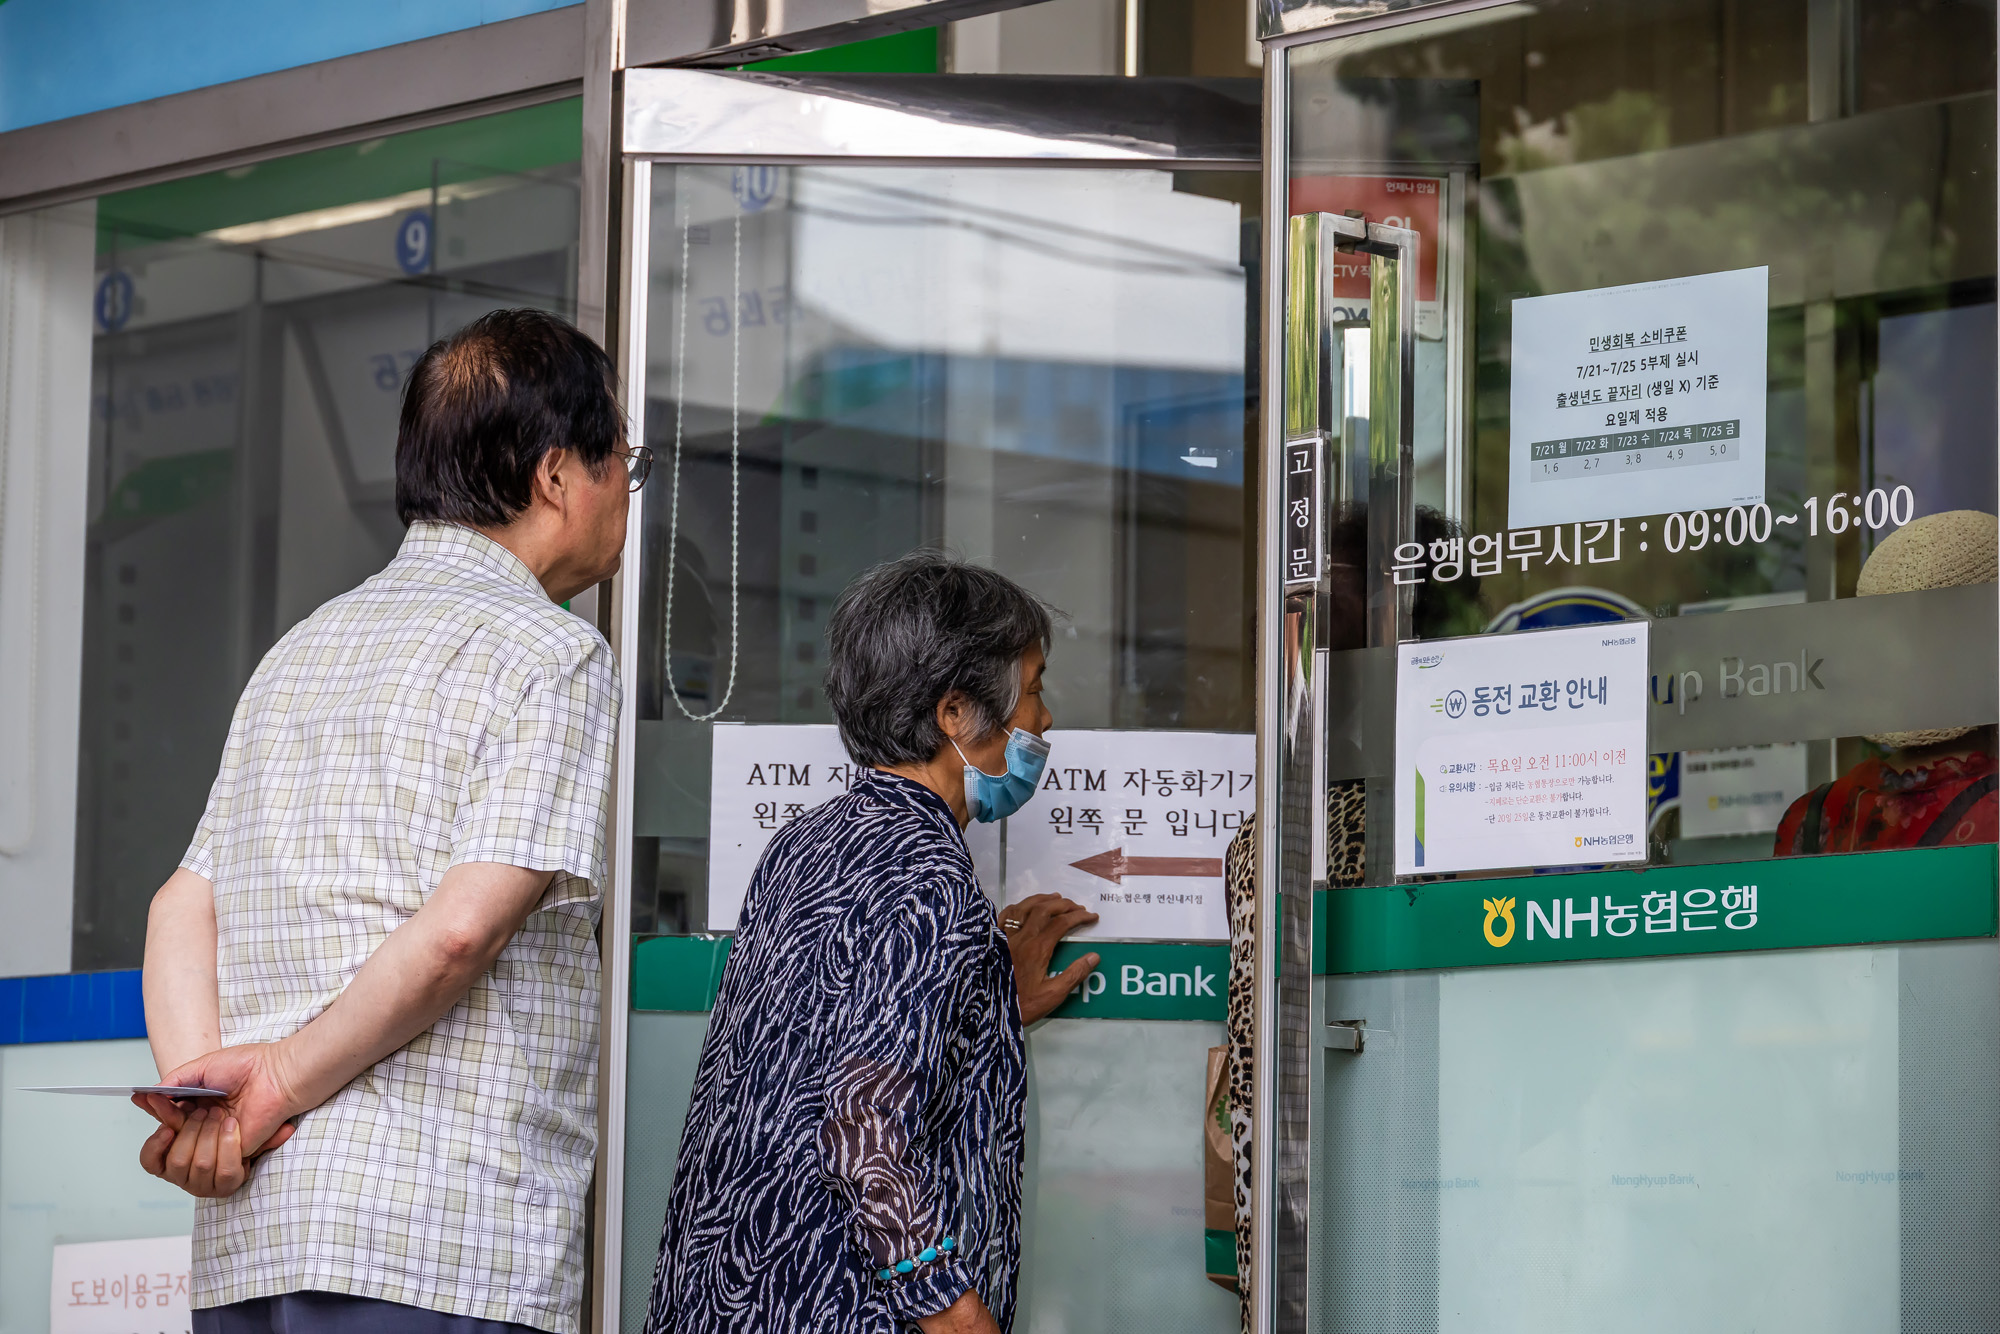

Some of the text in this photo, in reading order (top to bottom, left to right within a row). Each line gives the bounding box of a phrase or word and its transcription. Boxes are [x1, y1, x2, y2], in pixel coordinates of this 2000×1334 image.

[1385, 182, 1436, 194] 언제나 안심
[405, 221, 427, 266] 9
[1589, 325, 1687, 352] 민생회복 소비쿠폰
[1577, 350, 1699, 379] 7/21~7/25 5부제 실시
[1556, 374, 1719, 408] 출생년도 끝자리 (생일 X) 기준
[1605, 406, 1668, 427] 요일제 적용
[1535, 423, 1735, 456] 7/21 월 7/22 화 7/23 수 7/24 목 7/25 금
[1289, 450, 1313, 578] 고정문
[1391, 485, 1914, 586] 은행업무시간 : 09:00~16:00
[1601, 637, 1636, 647] NH농협금융
[1719, 648, 1825, 699] Bank
[1471, 683, 1512, 717] 동전
[1518, 679, 1560, 712] 교환
[1566, 675, 1607, 709] 안내
[1448, 763, 1476, 774] 교환시간
[1487, 756, 1522, 774] 목요일
[1526, 754, 1549, 770] 오전
[1555, 750, 1597, 768] 11:00시
[1603, 748, 1626, 765] 이전
[746, 763, 811, 786] ATM
[1042, 768, 1107, 791] ATM
[1448, 781, 1476, 793] 유의사항
[1505, 780, 1525, 790] 처리는
[1578, 774, 1614, 786] 가능합니다.
[1516, 793, 1548, 806] 단순교환은
[1550, 791, 1584, 803] 불가합니다.
[1049, 806, 1104, 836] 왼쪽
[1120, 808, 1148, 836] 문
[1497, 812, 1511, 823] 20일
[1514, 811, 1535, 823] 25일은
[1537, 808, 1572, 820] 동전교환이
[1574, 806, 1612, 819] 불가합니다.
[1583, 833, 1634, 846] NH농협은행
[1100, 893, 1203, 905] NH농협은행 연신내지점
[1526, 885, 1758, 941] NH농협은행
[1120, 964, 1217, 997] Bank
[1455, 1176, 1480, 1189] Bank
[1611, 1172, 1695, 1188] NongHyup Bank
[1835, 1170, 1895, 1185] NongHyup
